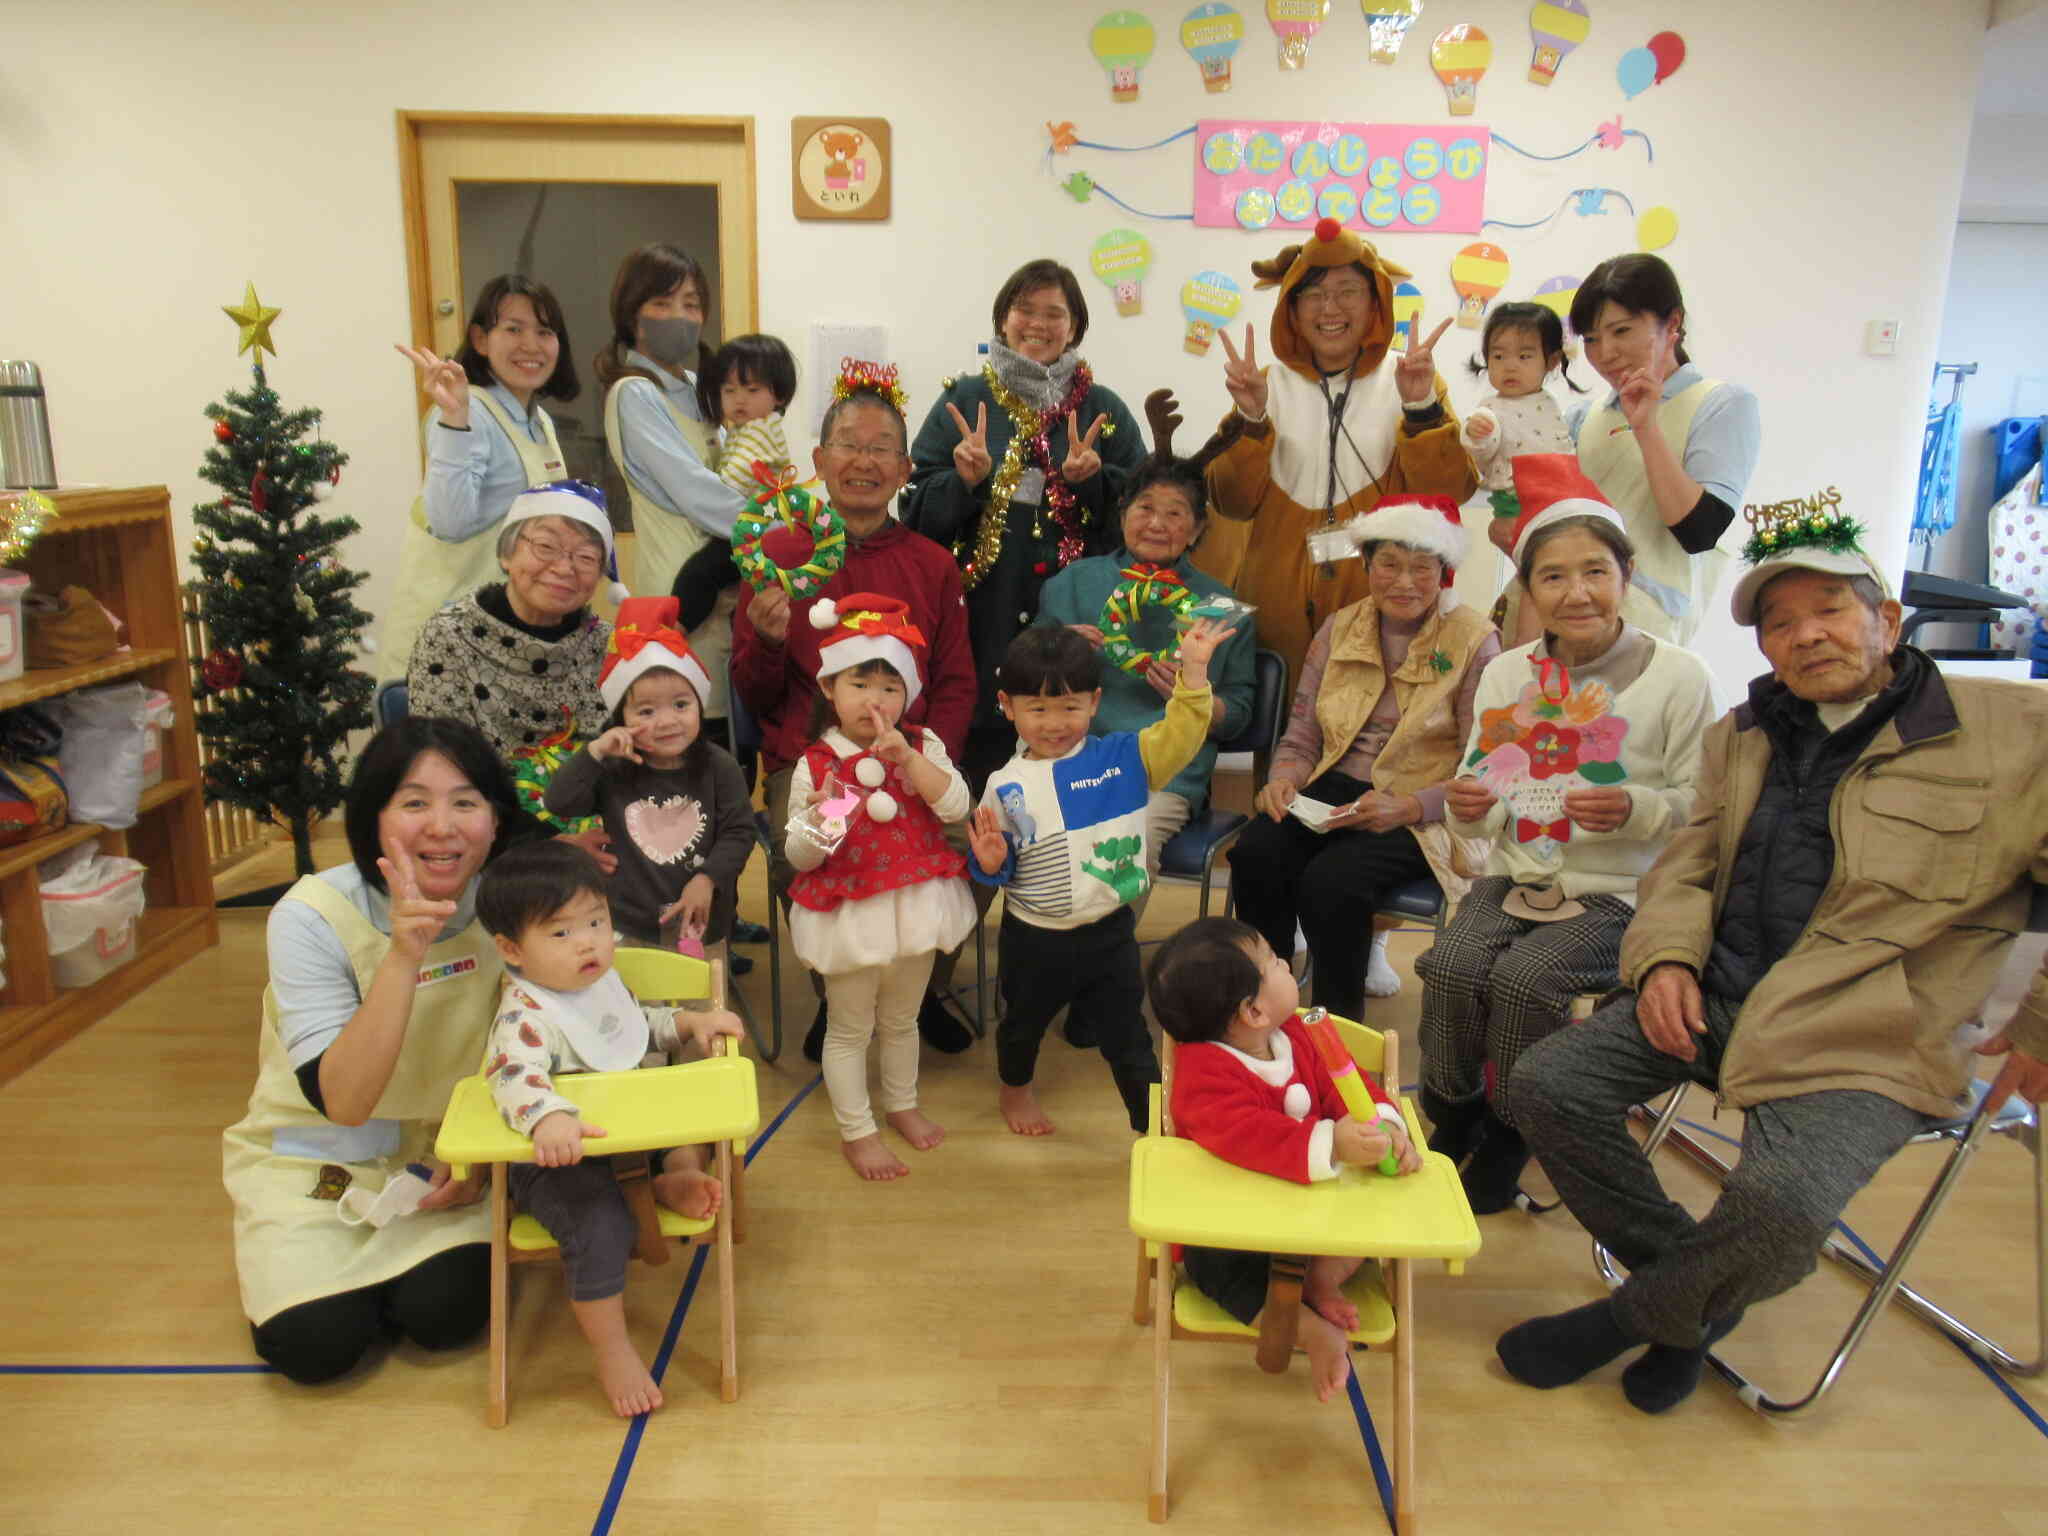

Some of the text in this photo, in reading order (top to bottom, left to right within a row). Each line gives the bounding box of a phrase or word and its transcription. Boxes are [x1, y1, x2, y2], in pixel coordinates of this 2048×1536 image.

[1208, 134, 1482, 187] おたんじょうび
[819, 190, 864, 204] といれ
[1239, 183, 1438, 224] おめでとう
[1481, 246, 1491, 257] 2
[1743, 485, 1842, 524] CHRISTMAS
